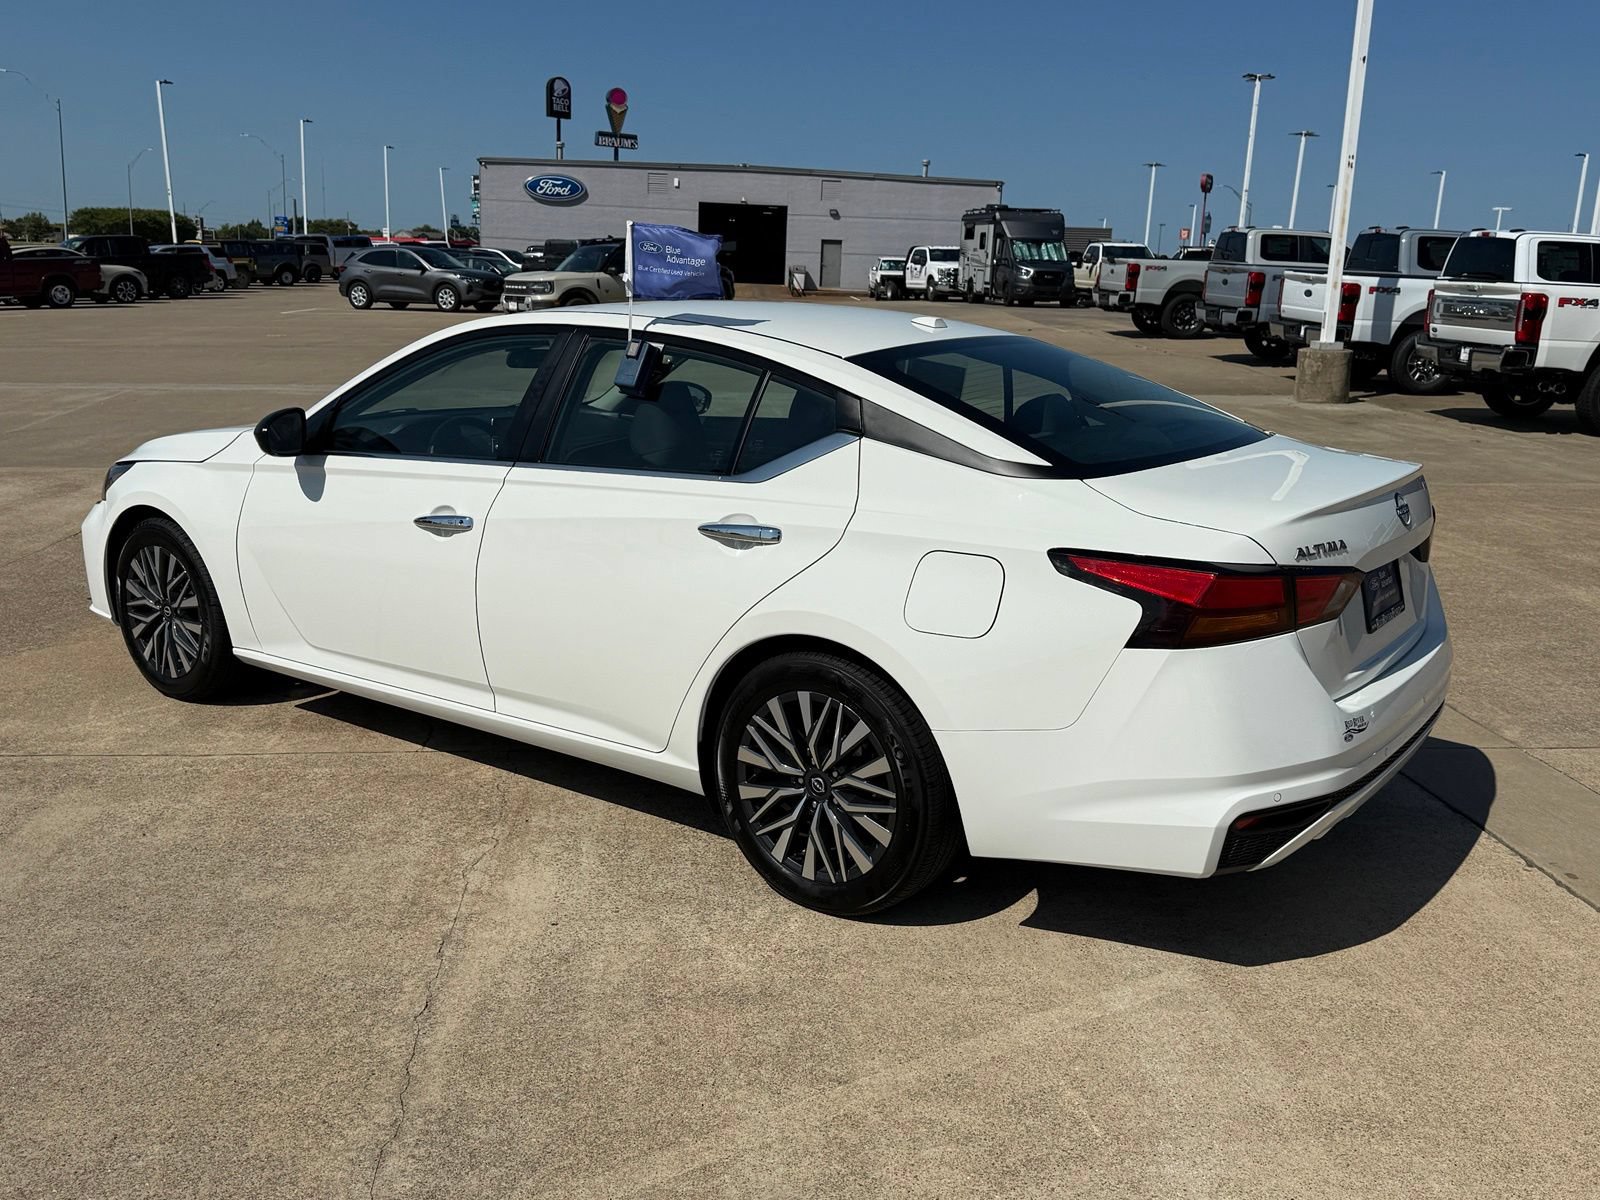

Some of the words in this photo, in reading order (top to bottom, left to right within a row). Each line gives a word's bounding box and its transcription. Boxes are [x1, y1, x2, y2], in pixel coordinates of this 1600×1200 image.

[552, 97, 570, 105] TACO
[553, 104, 569, 113] BELL
[536, 179, 572, 196] Ford
[642, 242, 658, 252] Ford
[665, 245, 681, 255] Blue
[666, 255, 706, 267] Advantage
[649, 265, 671, 275] Certified
[1558, 297, 1599, 307] FX4
[1294, 539, 1348, 561] ALTIMA
